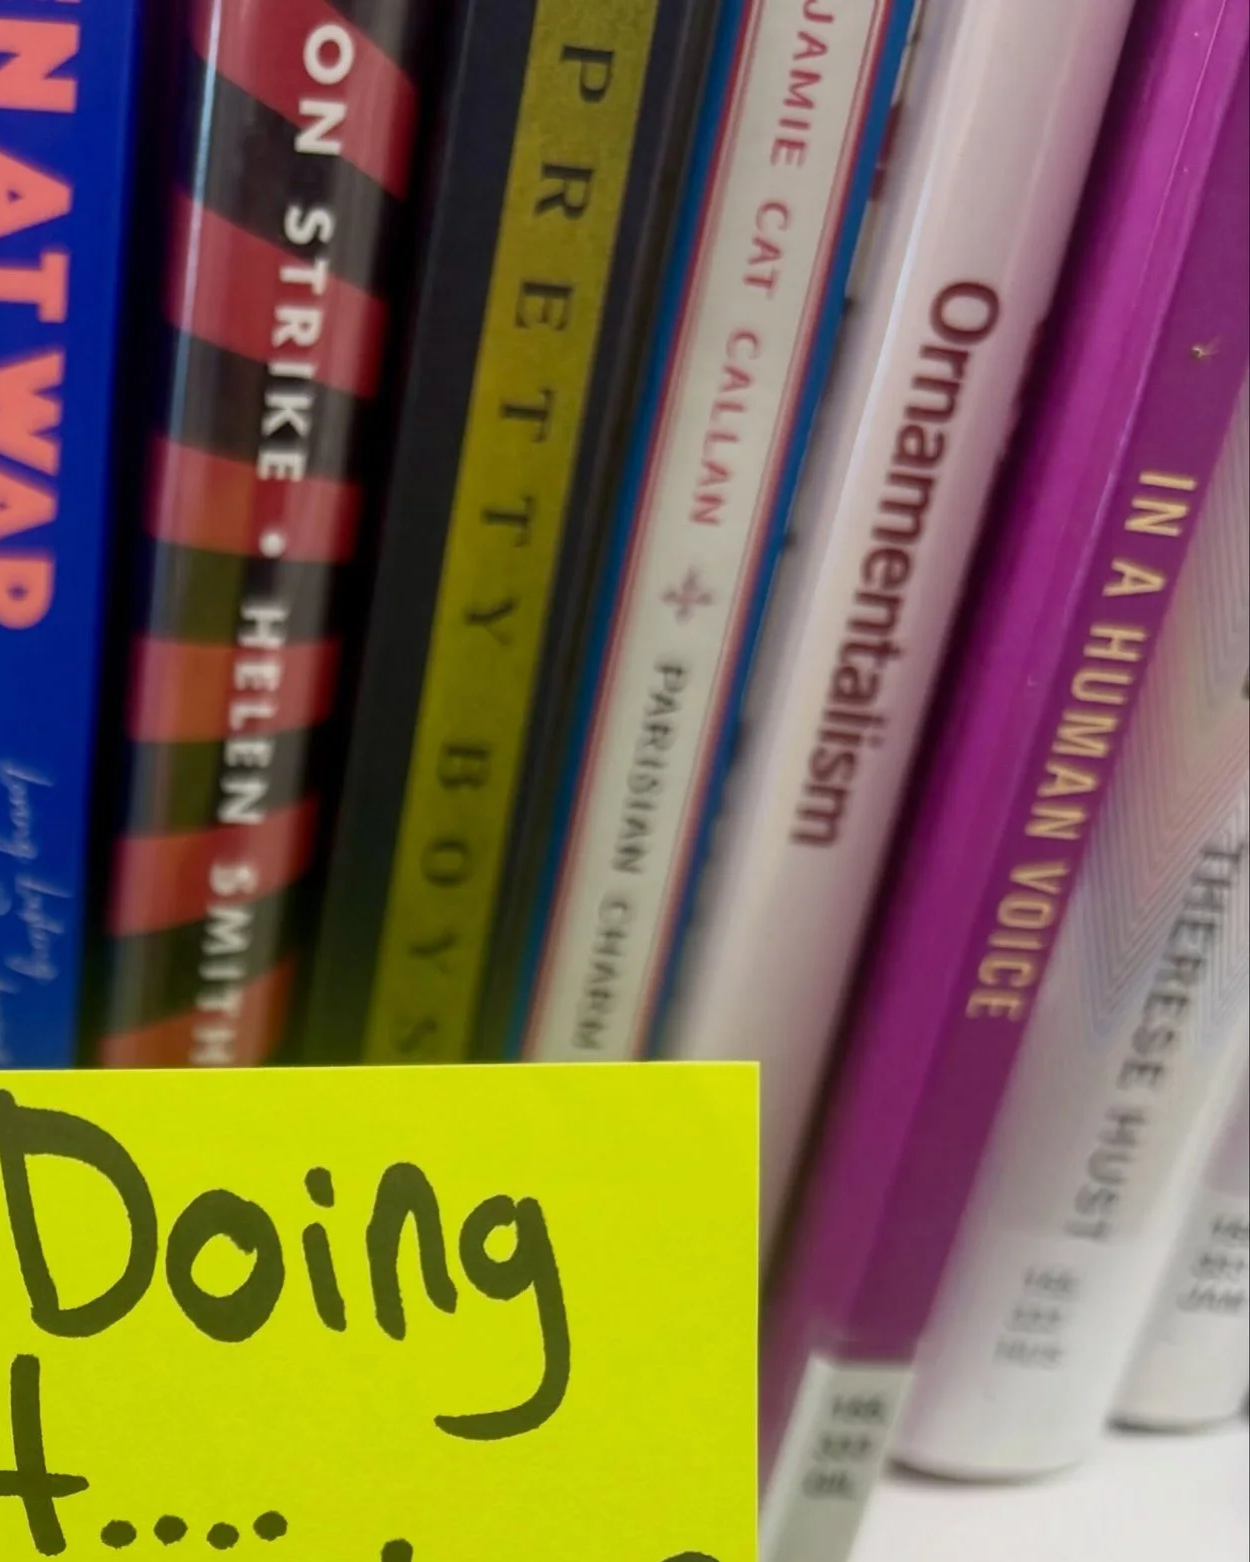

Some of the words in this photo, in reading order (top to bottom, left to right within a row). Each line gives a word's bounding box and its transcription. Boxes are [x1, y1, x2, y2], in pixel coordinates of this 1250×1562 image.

[294, 24, 354, 156] ON
[769, 0, 835, 170] JAMIE
[257, 205, 335, 483] STRIKE
[463, 43, 616, 647] PRETTY
[743, 199, 791, 298] CAT
[686, 328, 762, 528] CALLAN
[1125, 469, 1198, 538] IN
[790, 280, 1001, 849] Ornamentalism
[1102, 558, 1167, 598] A
[219, 604, 288, 826] HELEN
[609, 652, 691, 876] PARISIAN
[1025, 622, 1147, 842] HUMAN
[190, 861, 258, 1065] SMITH
[395, 740, 493, 1056] BOYS
[570, 891, 632, 1052] CHARM
[964, 856, 1072, 1024] VOICE
[1116, 842, 1246, 1094] THERESE
